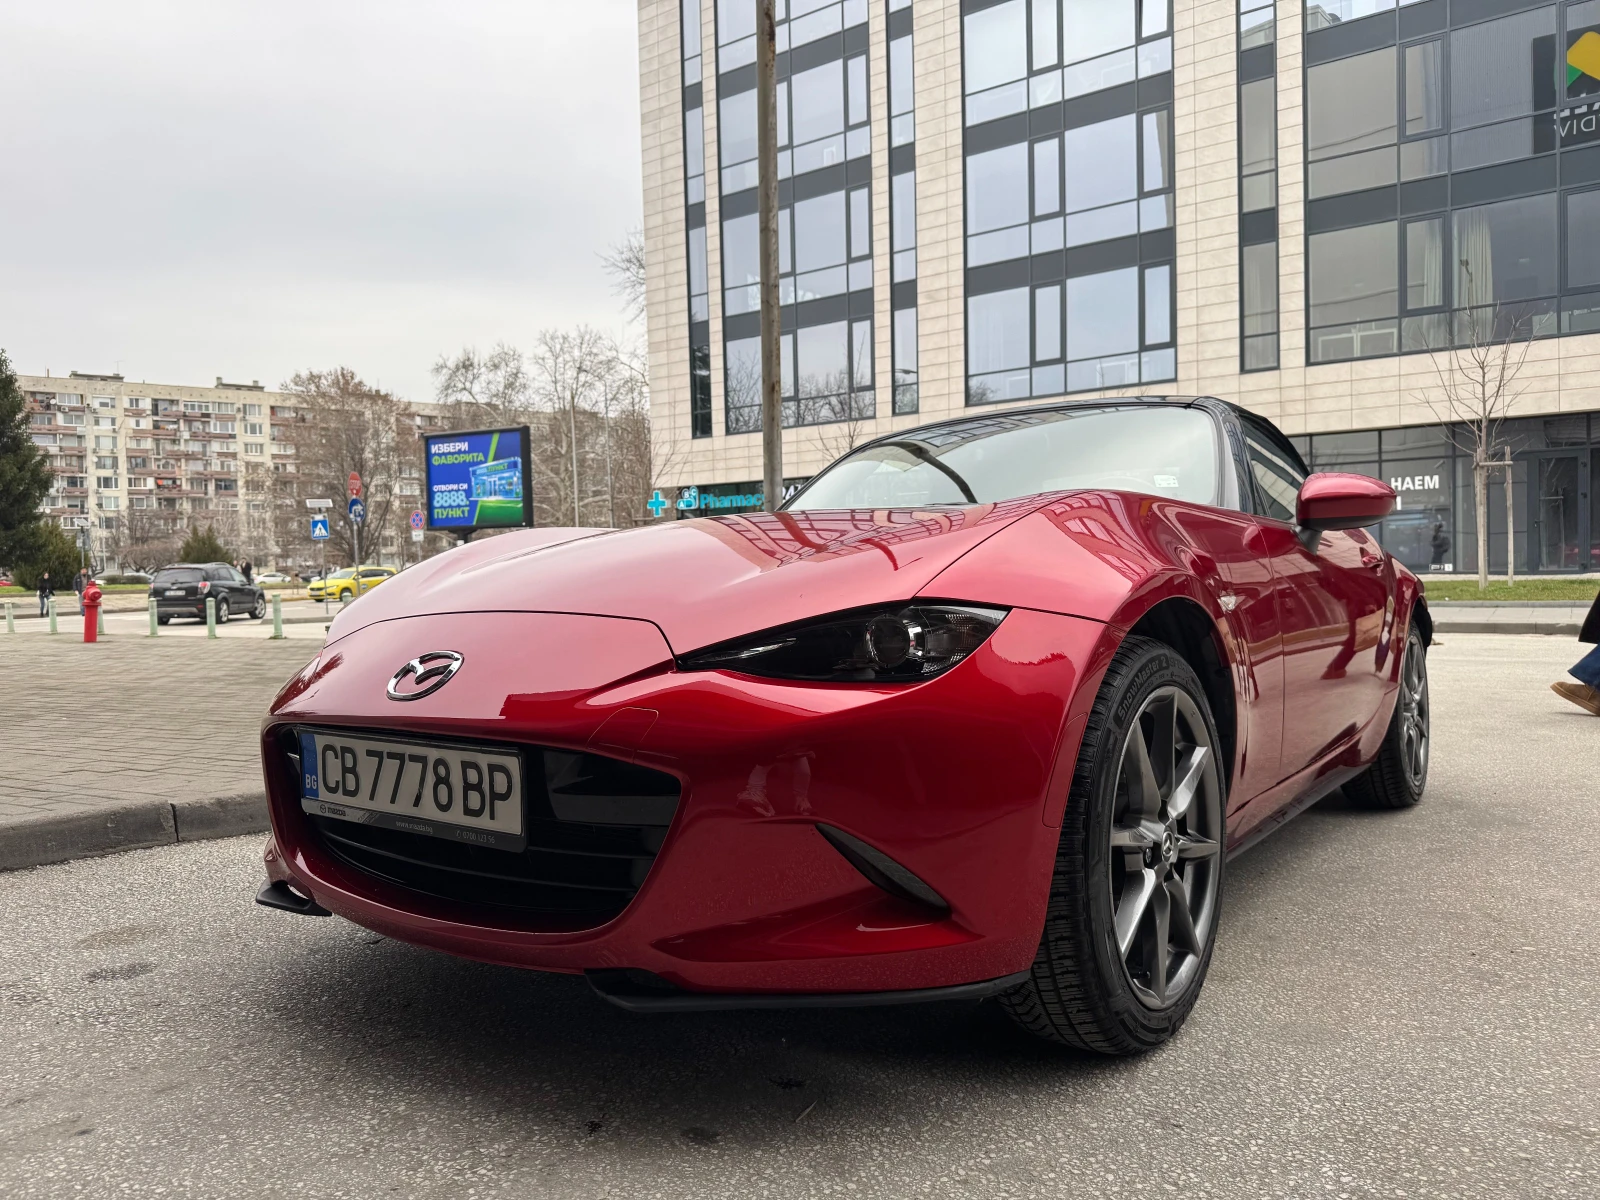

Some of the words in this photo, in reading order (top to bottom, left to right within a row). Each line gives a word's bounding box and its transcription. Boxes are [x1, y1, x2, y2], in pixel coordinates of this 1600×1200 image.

[431, 441, 469, 454] ИЗБЕРИ
[432, 452, 485, 466] ФАВОРИТА
[433, 484, 458, 492] ОТВОРИ
[700, 493, 766, 509] Pharmac
[434, 507, 470, 519] ПУНКТ
[1117, 660, 1160, 720] SnowMaster
[1161, 656, 1168, 667] 2
[305, 774, 318, 790] BG
[321, 743, 360, 798] CB
[365, 749, 453, 813] 7778
[460, 760, 513, 821] BP
